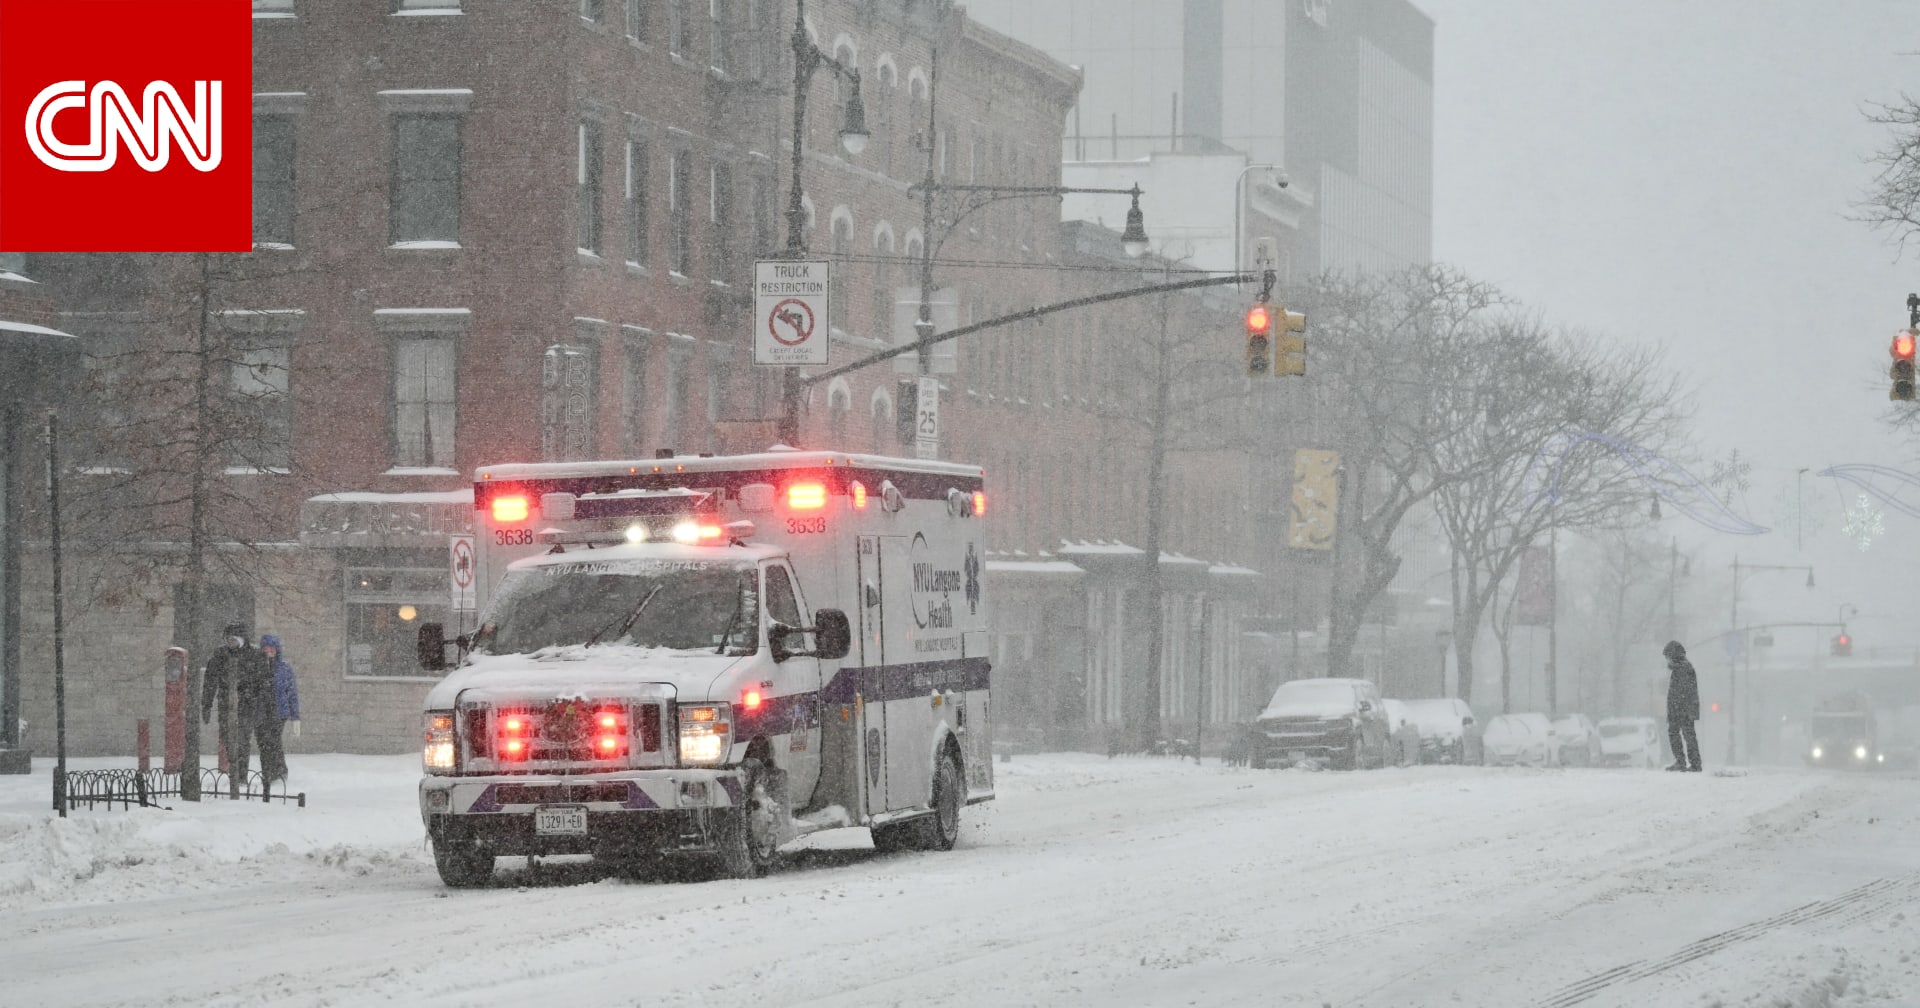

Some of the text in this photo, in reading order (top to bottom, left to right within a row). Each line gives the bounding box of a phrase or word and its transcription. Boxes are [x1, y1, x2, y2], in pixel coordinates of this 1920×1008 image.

[774, 266, 809, 278] TRUCK
[761, 282, 823, 292] RESTRICTION
[565, 354, 588, 458] BAR
[919, 411, 936, 434] 25
[786, 516, 826, 534] 3638
[495, 529, 533, 546] 3638
[546, 566, 572, 577] NYU
[912, 562, 961, 599] NYU Langone
[928, 598, 953, 629] Health
